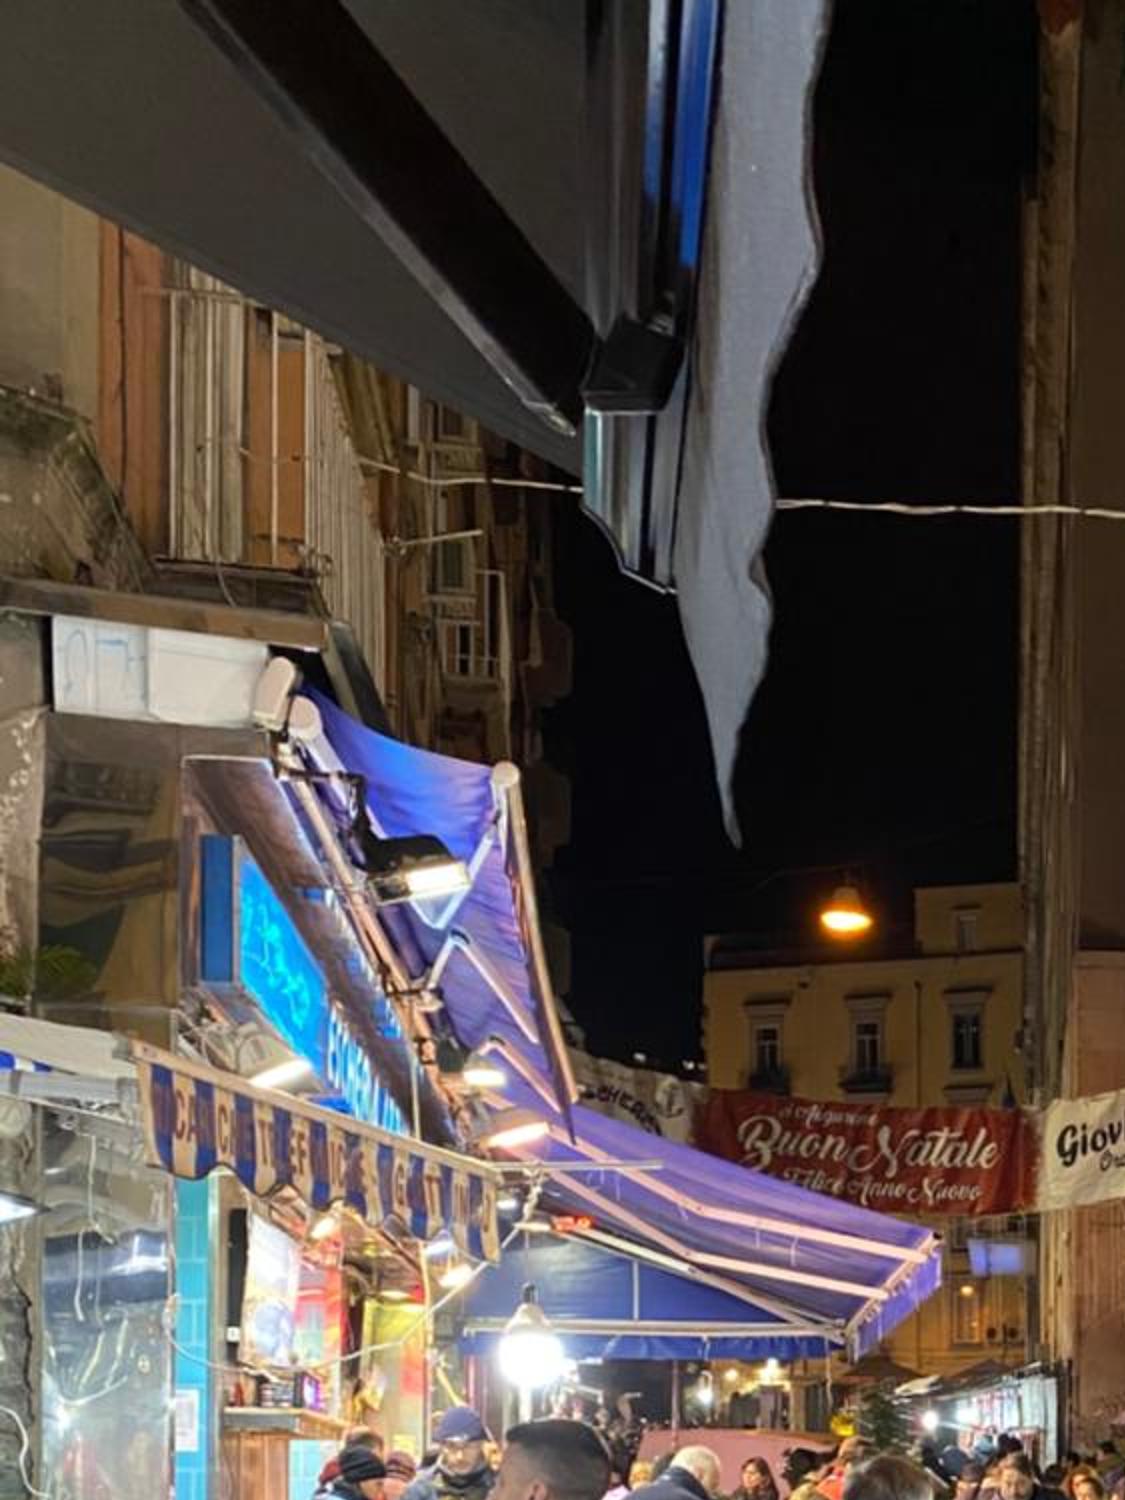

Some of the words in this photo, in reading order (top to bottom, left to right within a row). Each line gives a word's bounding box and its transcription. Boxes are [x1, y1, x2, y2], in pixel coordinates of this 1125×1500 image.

[736, 1115, 848, 1171] Buon
[847, 1125, 999, 1178] Natale
[850, 1175, 904, 1205] Anno
[905, 1177, 983, 1205] Nuovo
